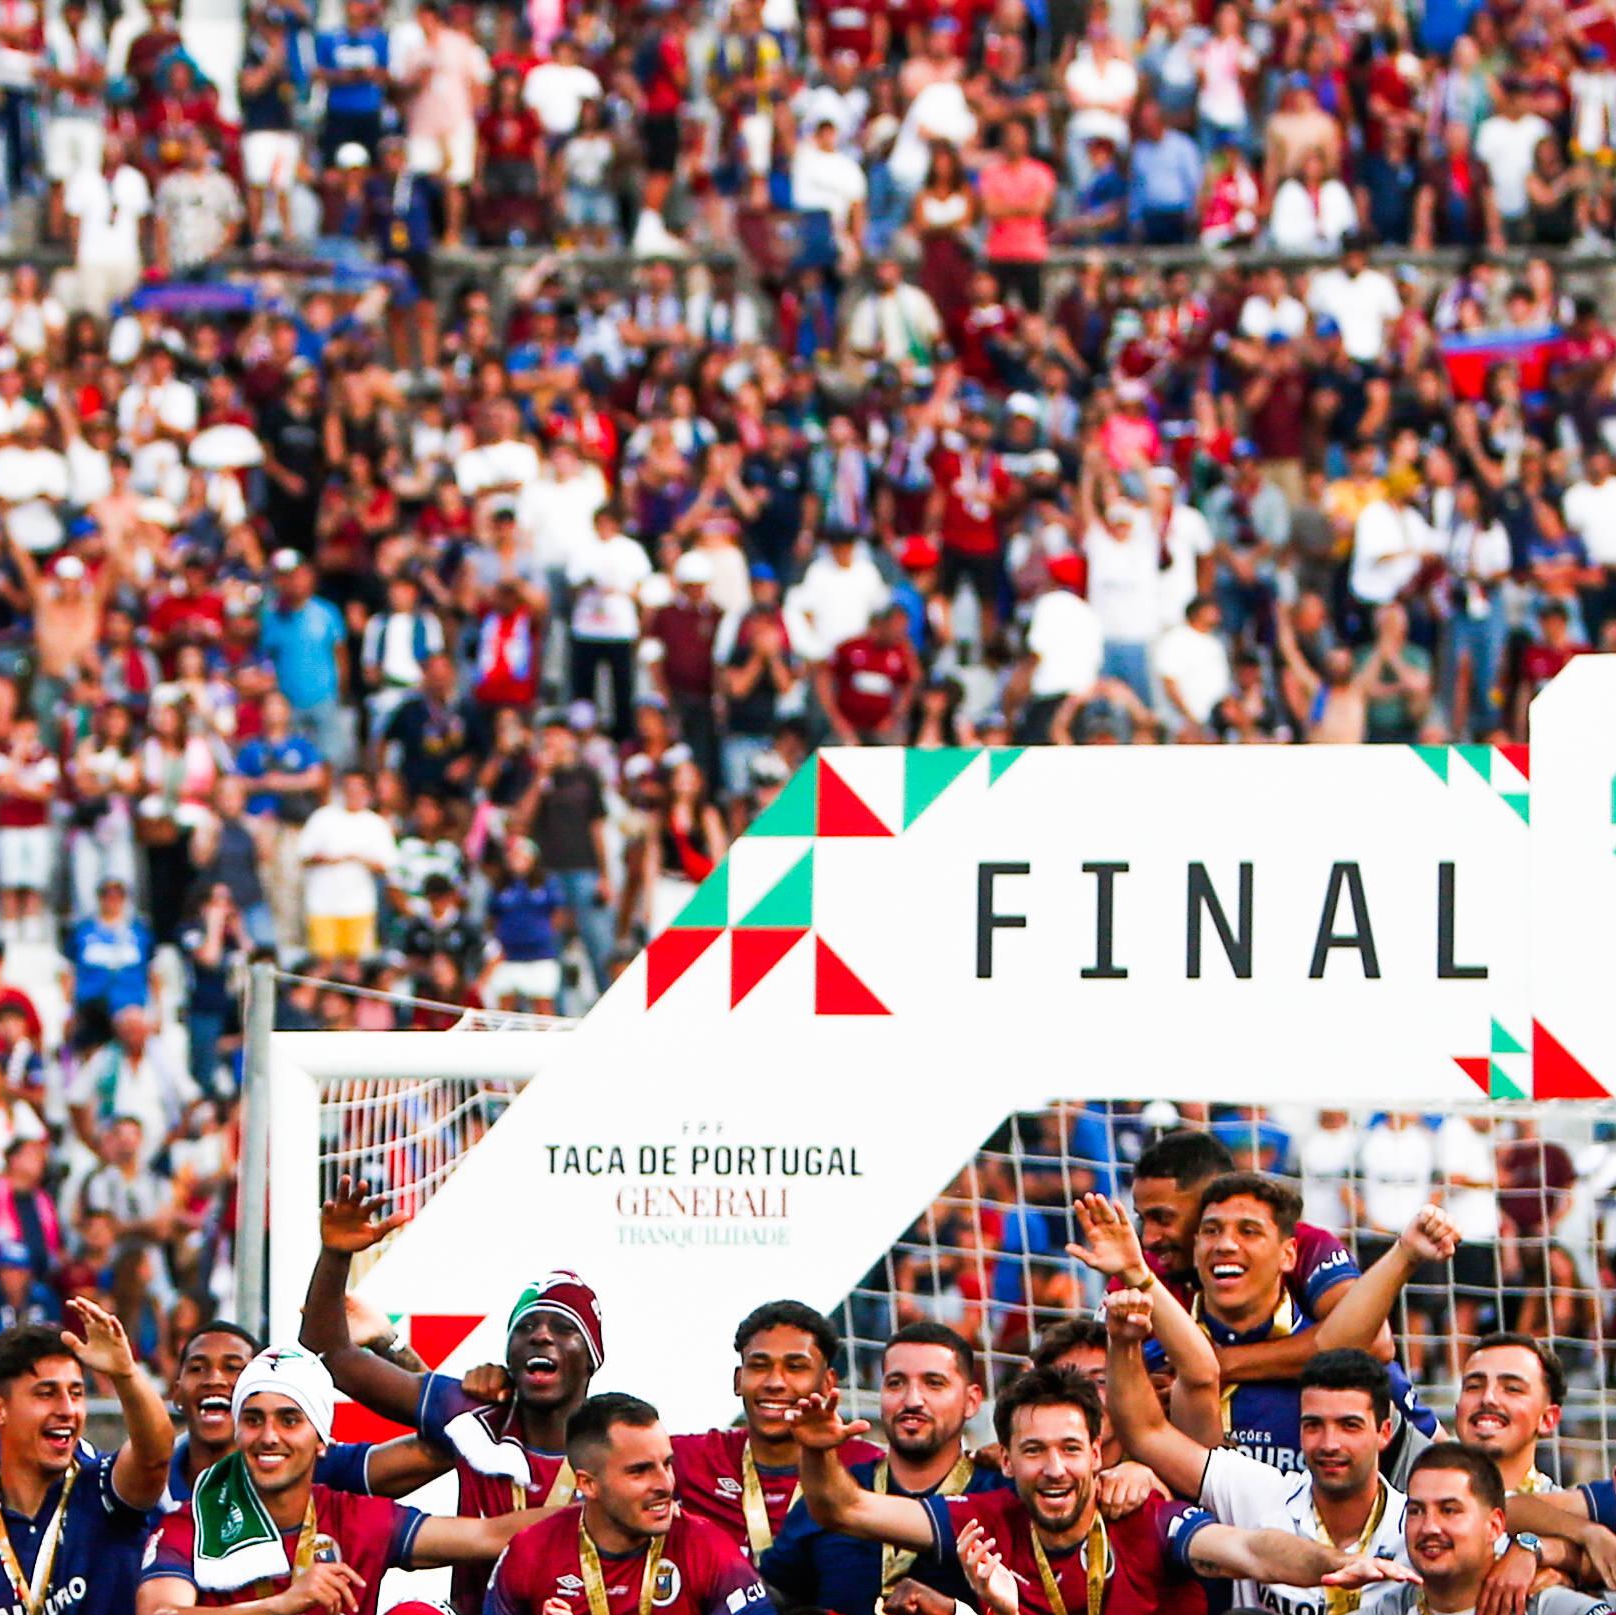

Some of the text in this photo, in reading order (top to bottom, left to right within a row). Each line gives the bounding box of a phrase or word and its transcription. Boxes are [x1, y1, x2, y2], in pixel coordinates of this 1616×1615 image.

[976, 862, 1489, 979] FINAL
[638, 1145, 678, 1176] DE
[691, 1145, 865, 1176] PORTUGAL
[616, 1187, 789, 1219] GENERALI
[618, 1225, 791, 1247] TRANQUILIDADE
